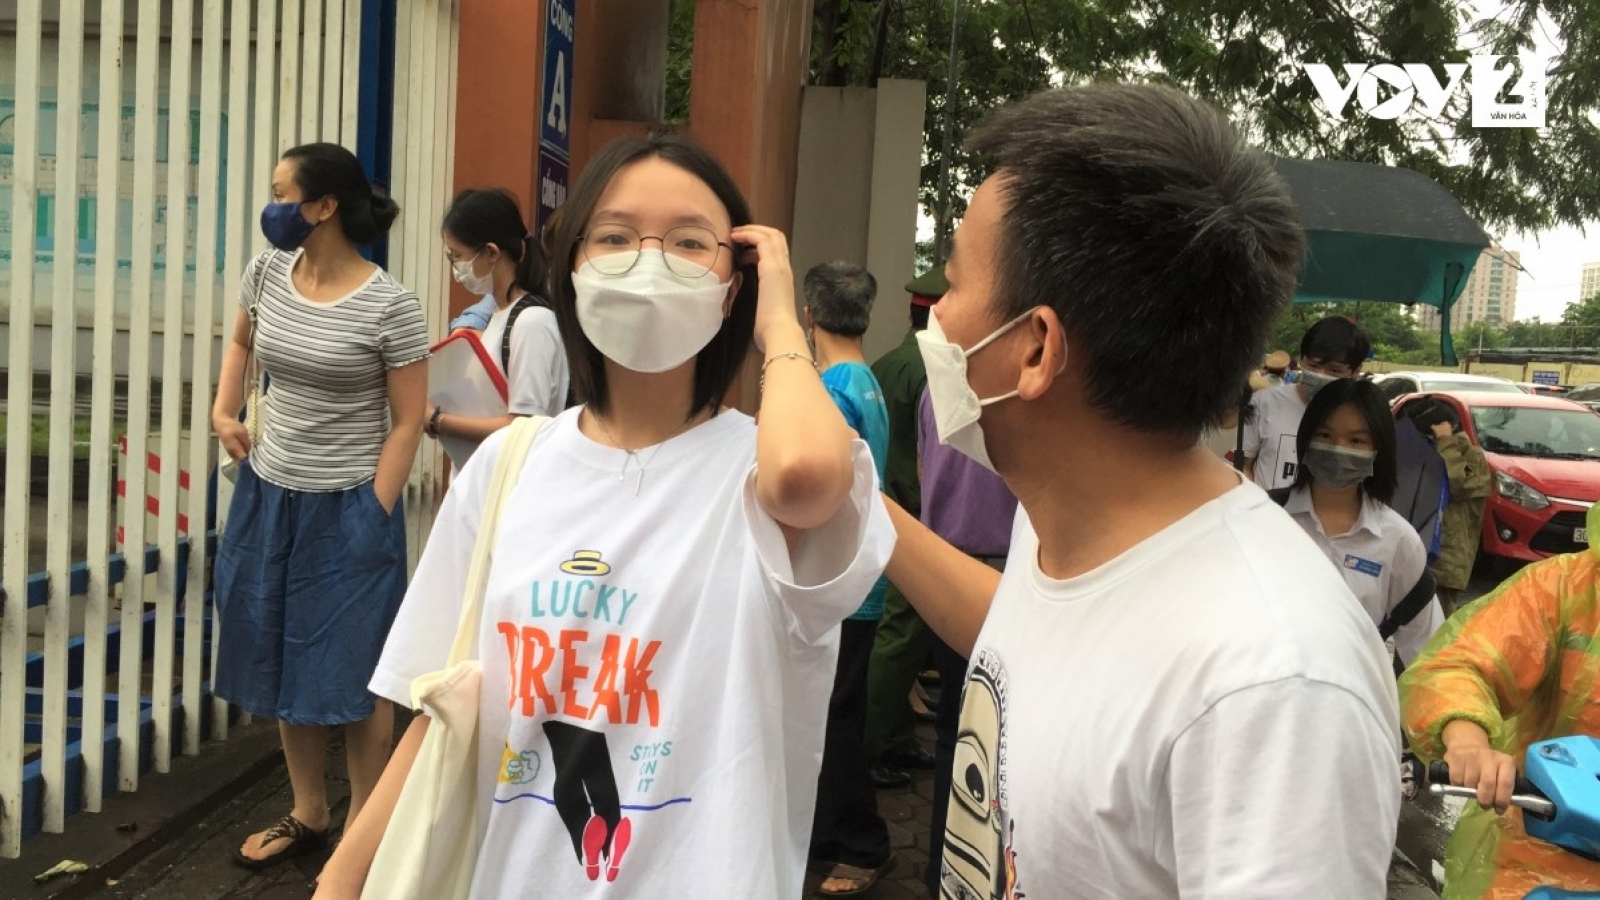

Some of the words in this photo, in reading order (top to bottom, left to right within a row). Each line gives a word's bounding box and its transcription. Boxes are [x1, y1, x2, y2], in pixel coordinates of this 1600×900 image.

[547, 50, 567, 133] A
[531, 580, 638, 626] LUCKY
[637, 778, 655, 792] IT
